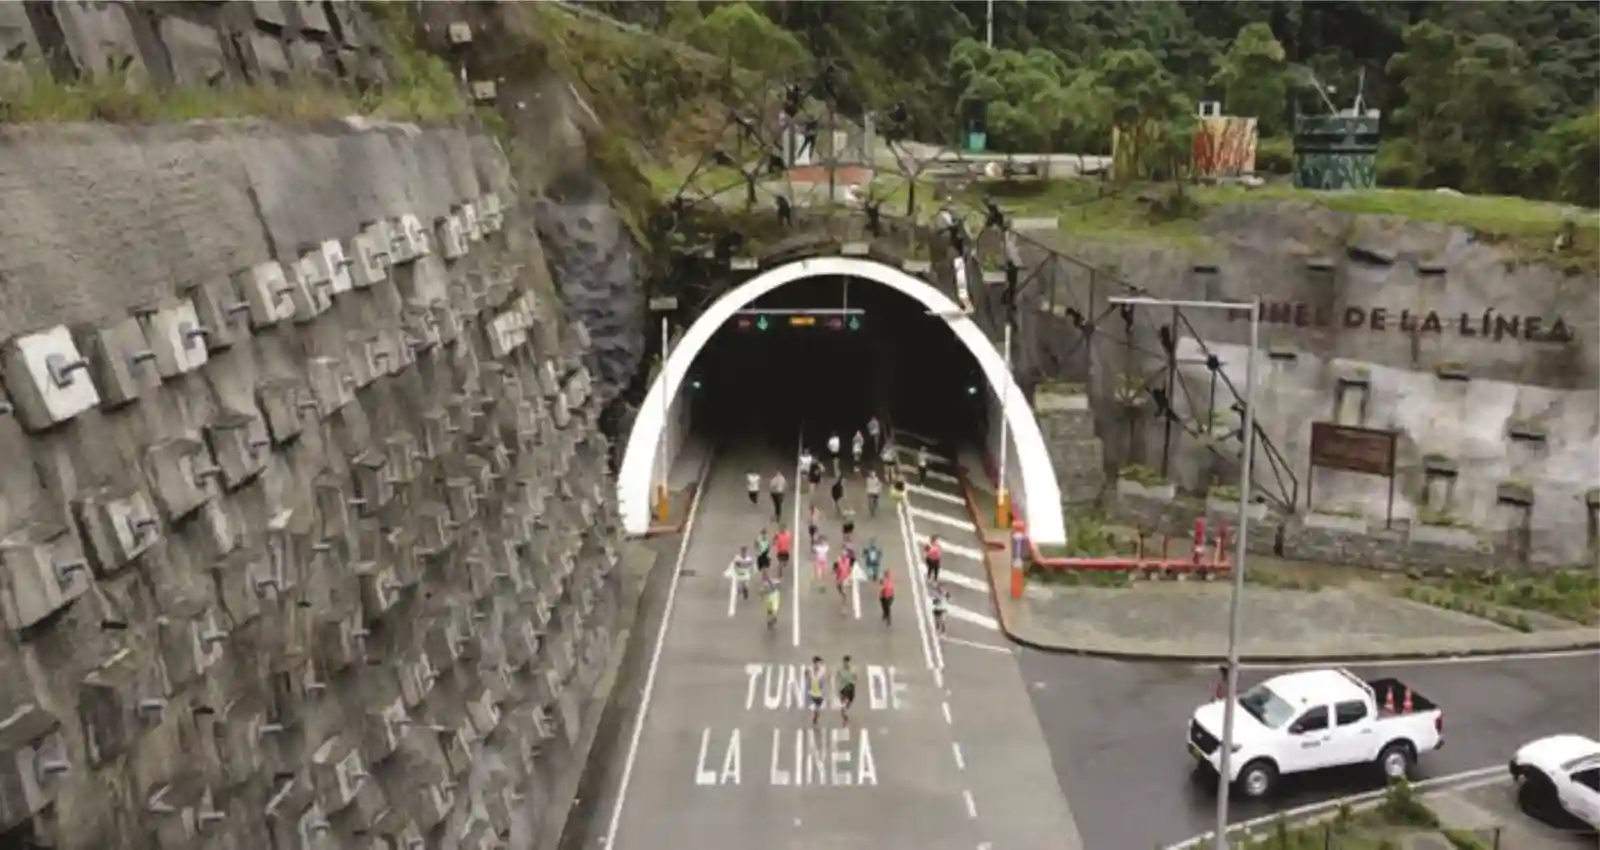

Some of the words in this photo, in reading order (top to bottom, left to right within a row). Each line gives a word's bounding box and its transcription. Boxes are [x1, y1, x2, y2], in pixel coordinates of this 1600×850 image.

[1344, 305, 1387, 330] DE
[1400, 308, 1442, 333] LA
[1459, 306, 1574, 342] LÍNEA
[744, 664, 846, 711] TUNL
[867, 664, 909, 710] DE
[696, 728, 741, 785] LA
[770, 728, 878, 785] LINEA
